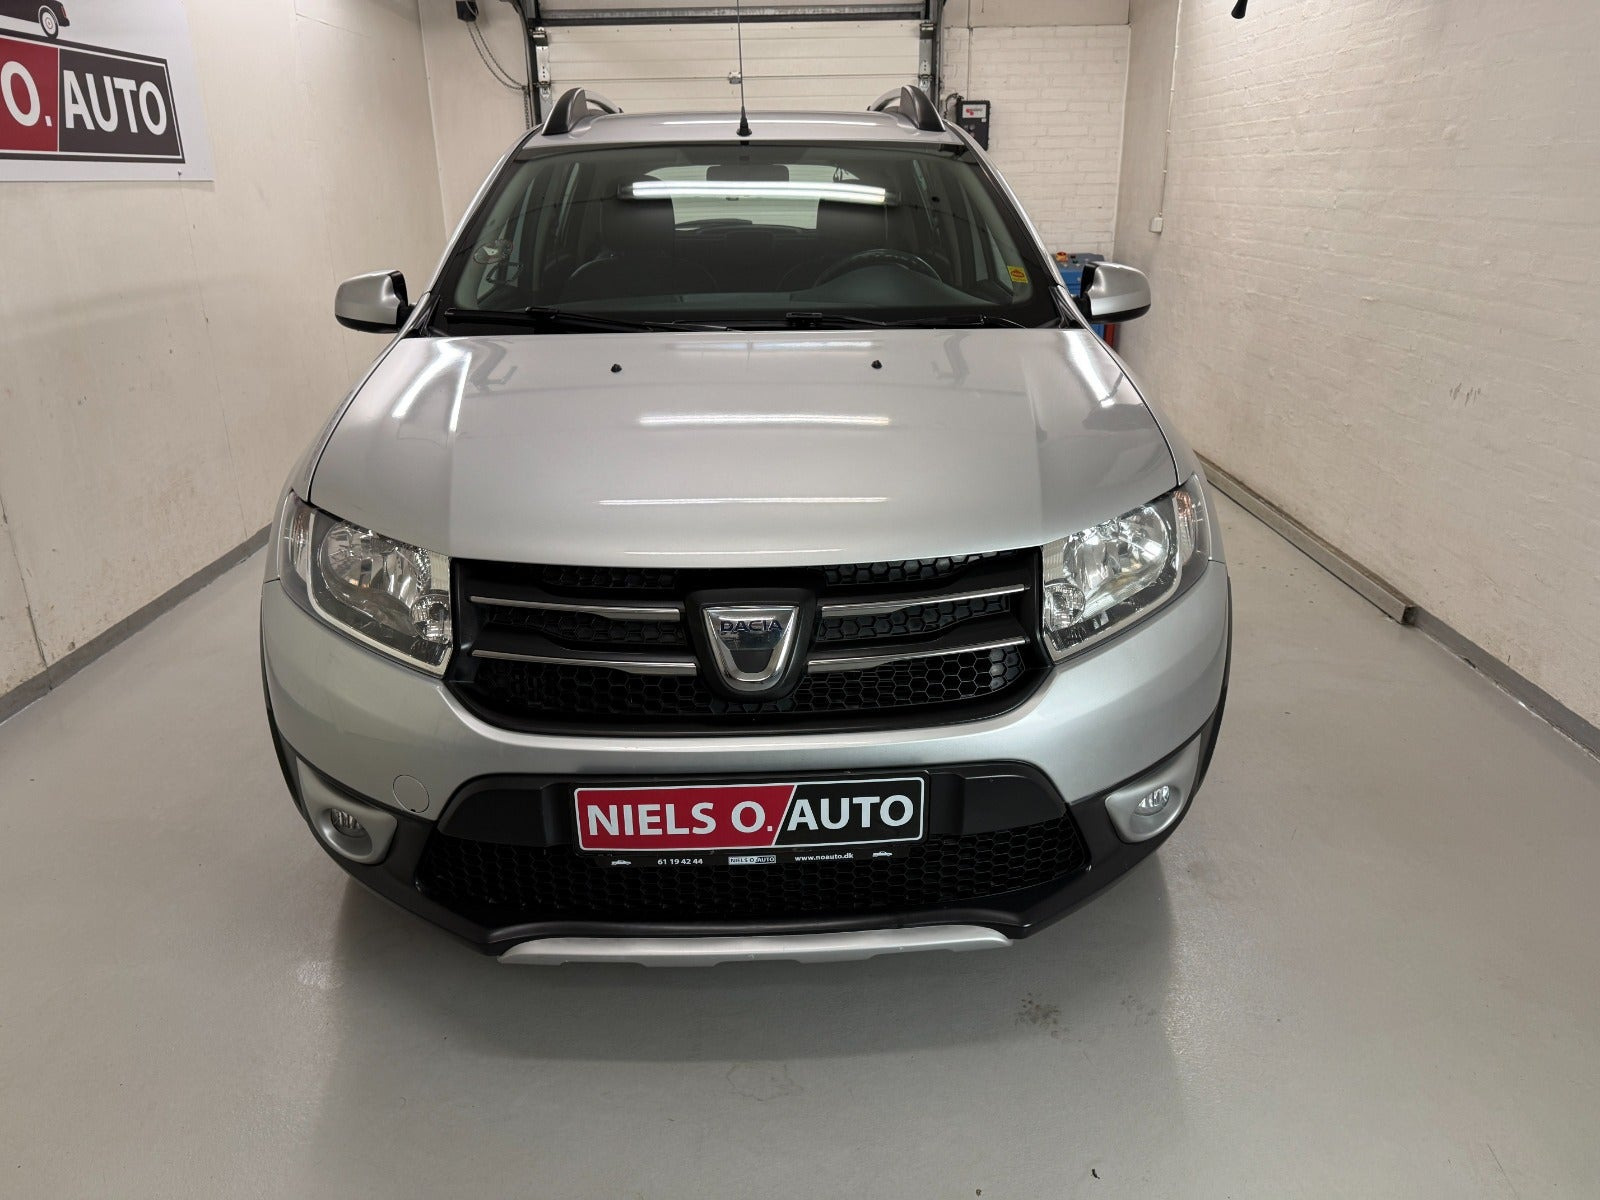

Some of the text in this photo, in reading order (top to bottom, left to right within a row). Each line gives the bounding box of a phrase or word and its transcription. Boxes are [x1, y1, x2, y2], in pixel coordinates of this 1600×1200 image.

[1, 60, 167, 136] O. AUTO
[720, 619, 782, 633] DACIA
[587, 795, 913, 835] NIELS O. AUTO
[794, 852, 854, 861] www.noauto.dk
